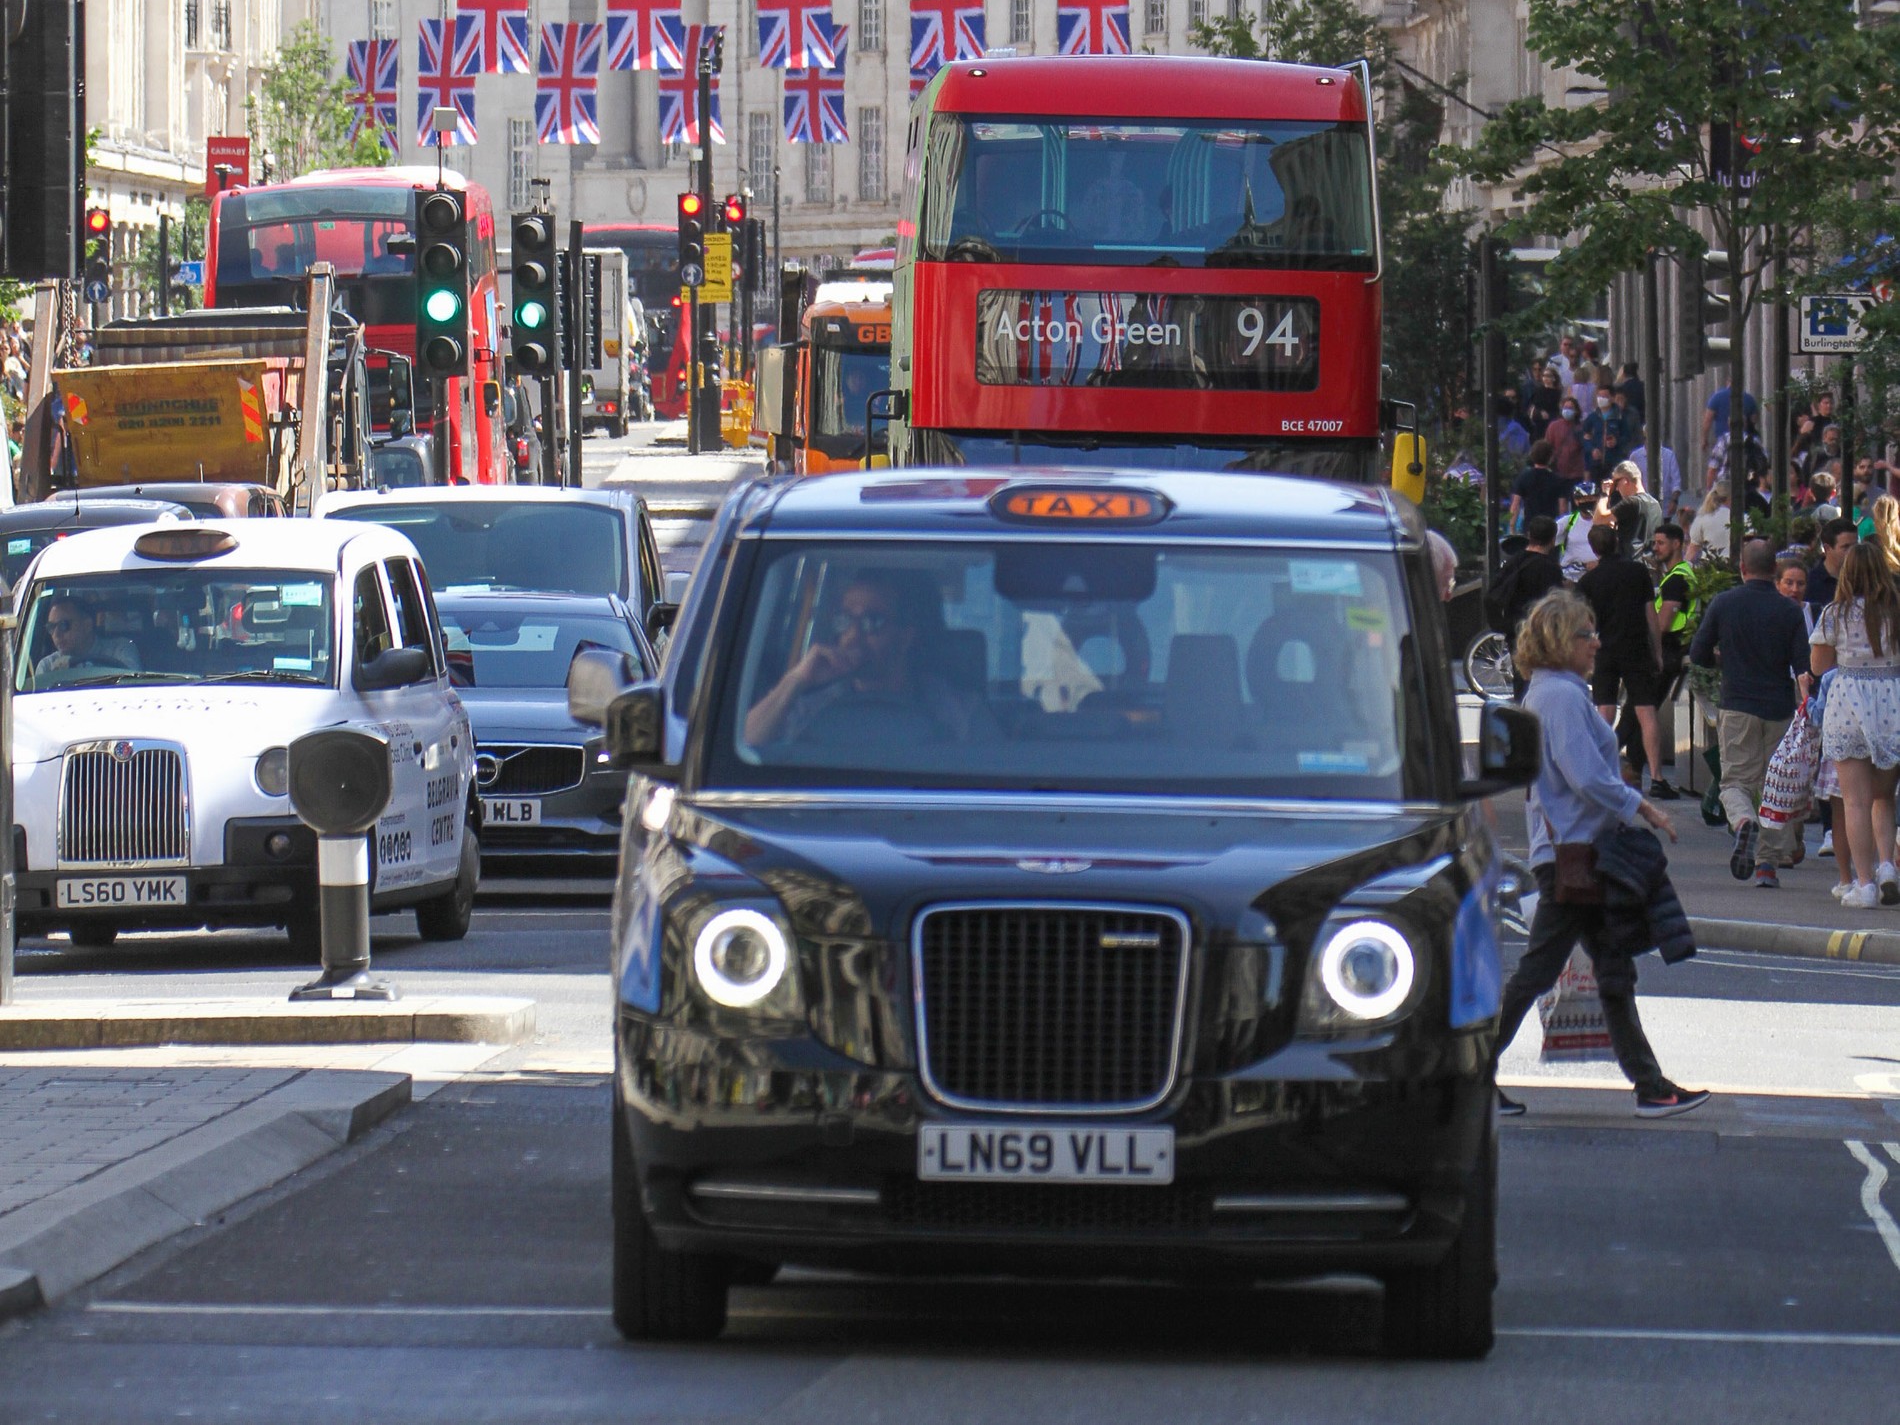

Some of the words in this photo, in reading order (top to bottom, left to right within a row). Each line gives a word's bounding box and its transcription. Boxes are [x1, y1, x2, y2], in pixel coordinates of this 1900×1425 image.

[210, 147, 247, 156] CARNABY
[994, 310, 1082, 343] Acton
[1091, 312, 1181, 346] Green
[1237, 307, 1300, 357] 94
[1804, 337, 1857, 349] Burlington
[1281, 420, 1304, 431] BCE
[1307, 420, 1343, 432] 47007
[1022, 496, 1138, 516] TAXI
[427, 773, 460, 809] BELGRAVIA
[493, 802, 533, 822] WLB
[431, 813, 455, 847] CENTRE
[67, 881, 125, 904] LS60
[132, 879, 177, 902] YMK
[939, 1132, 1055, 1174] LN69
[1069, 1133, 1154, 1175] VLL
